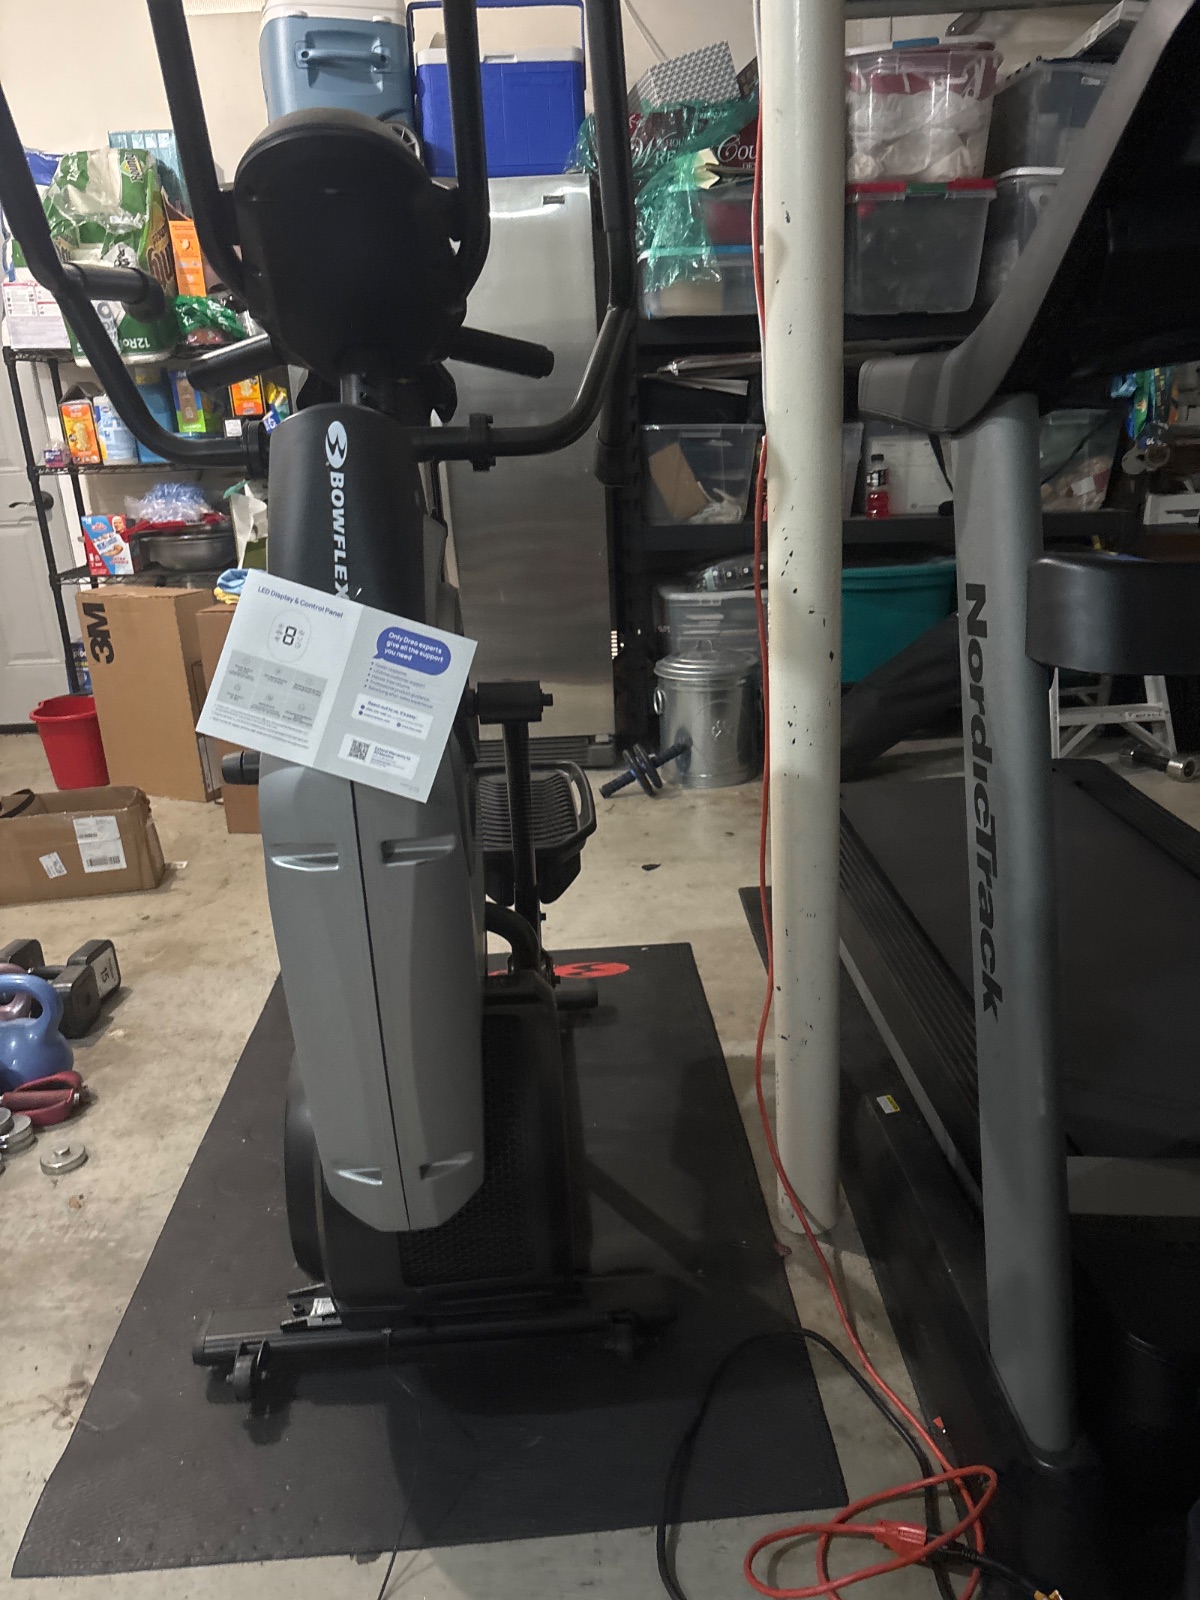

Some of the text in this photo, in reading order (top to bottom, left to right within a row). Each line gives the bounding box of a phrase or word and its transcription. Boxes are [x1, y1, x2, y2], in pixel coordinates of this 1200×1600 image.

[330, 471, 350, 599] BOWFLEX
[258, 586, 271, 596] LED
[270, 590, 294, 604] Display
[300, 600, 324, 612] Control
[325, 607, 344, 618] Panel
[82, 602, 115, 665] 3M
[282, 625, 298, 646] 8
[388, 632, 404, 643] Only
[419, 640, 442, 655] experts
[384, 648, 412, 662] you need
[386, 640, 443, 663] give all the support
[965, 583, 1004, 1023] NordicTrack
[101, 967, 109, 983] 15
